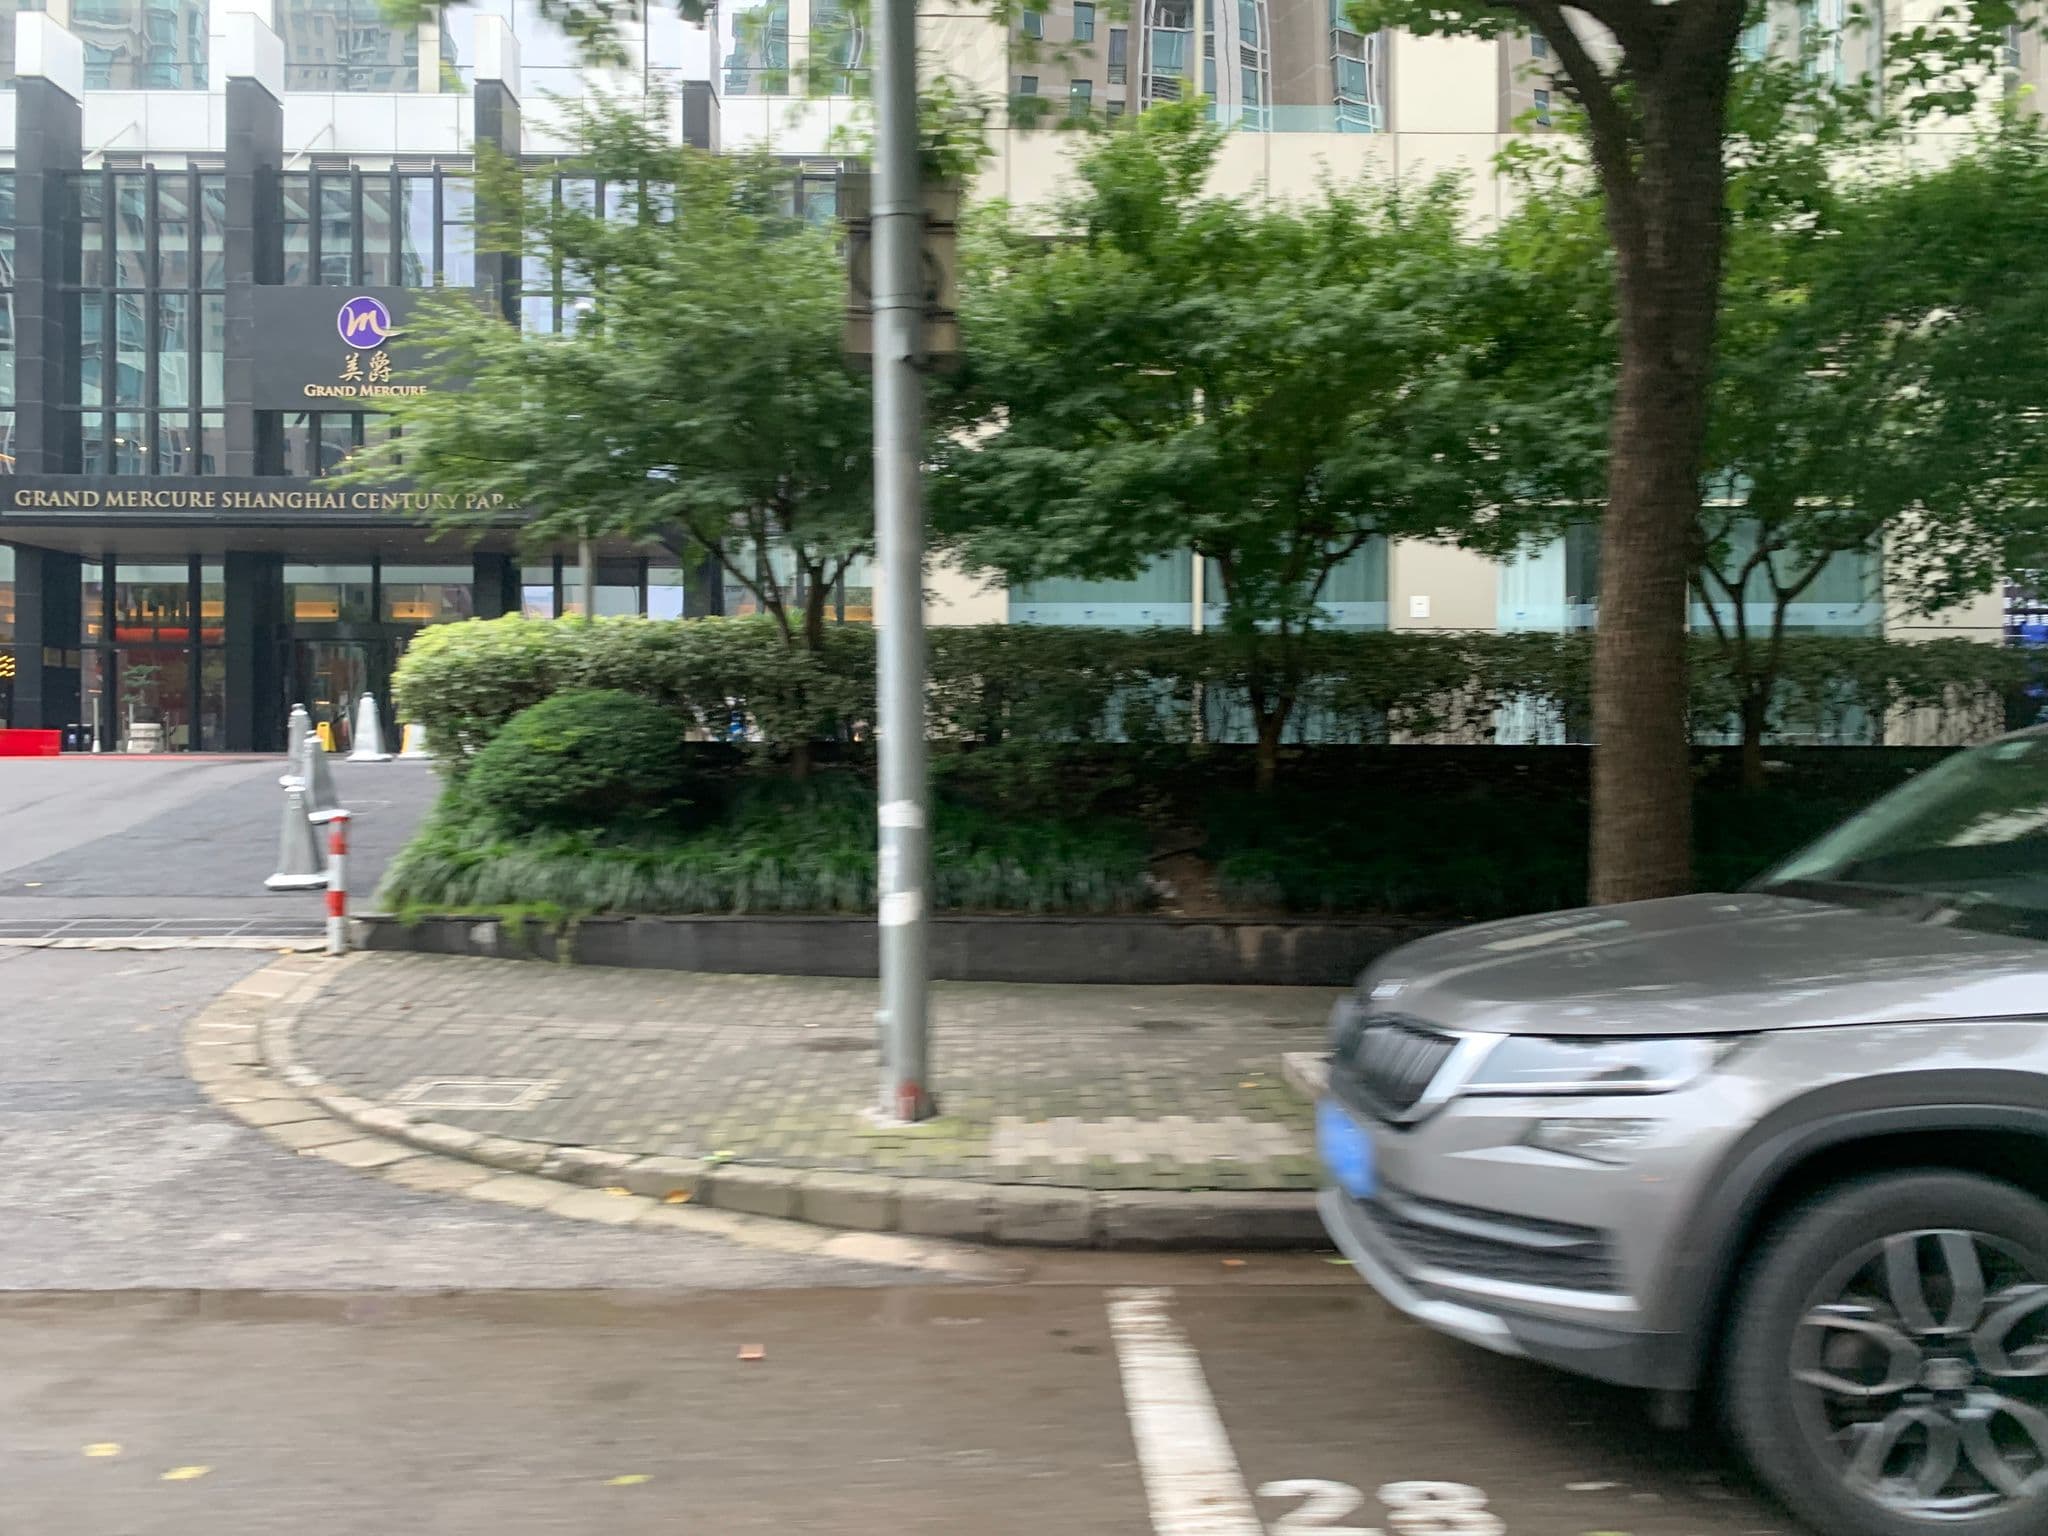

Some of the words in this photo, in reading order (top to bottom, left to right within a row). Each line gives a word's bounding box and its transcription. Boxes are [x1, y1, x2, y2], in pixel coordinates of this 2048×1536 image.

[338, 351, 393, 383] 美爵
[303, 383, 357, 398] GRAND
[359, 385, 427, 398] MERCURE
[14, 489, 100, 507] GRAND
[104, 490, 216, 508] MERCURE
[221, 491, 346, 509] SHANGHAI
[351, 492, 458, 510] CENTURY
[1255, 1478, 1507, 1536] 28
